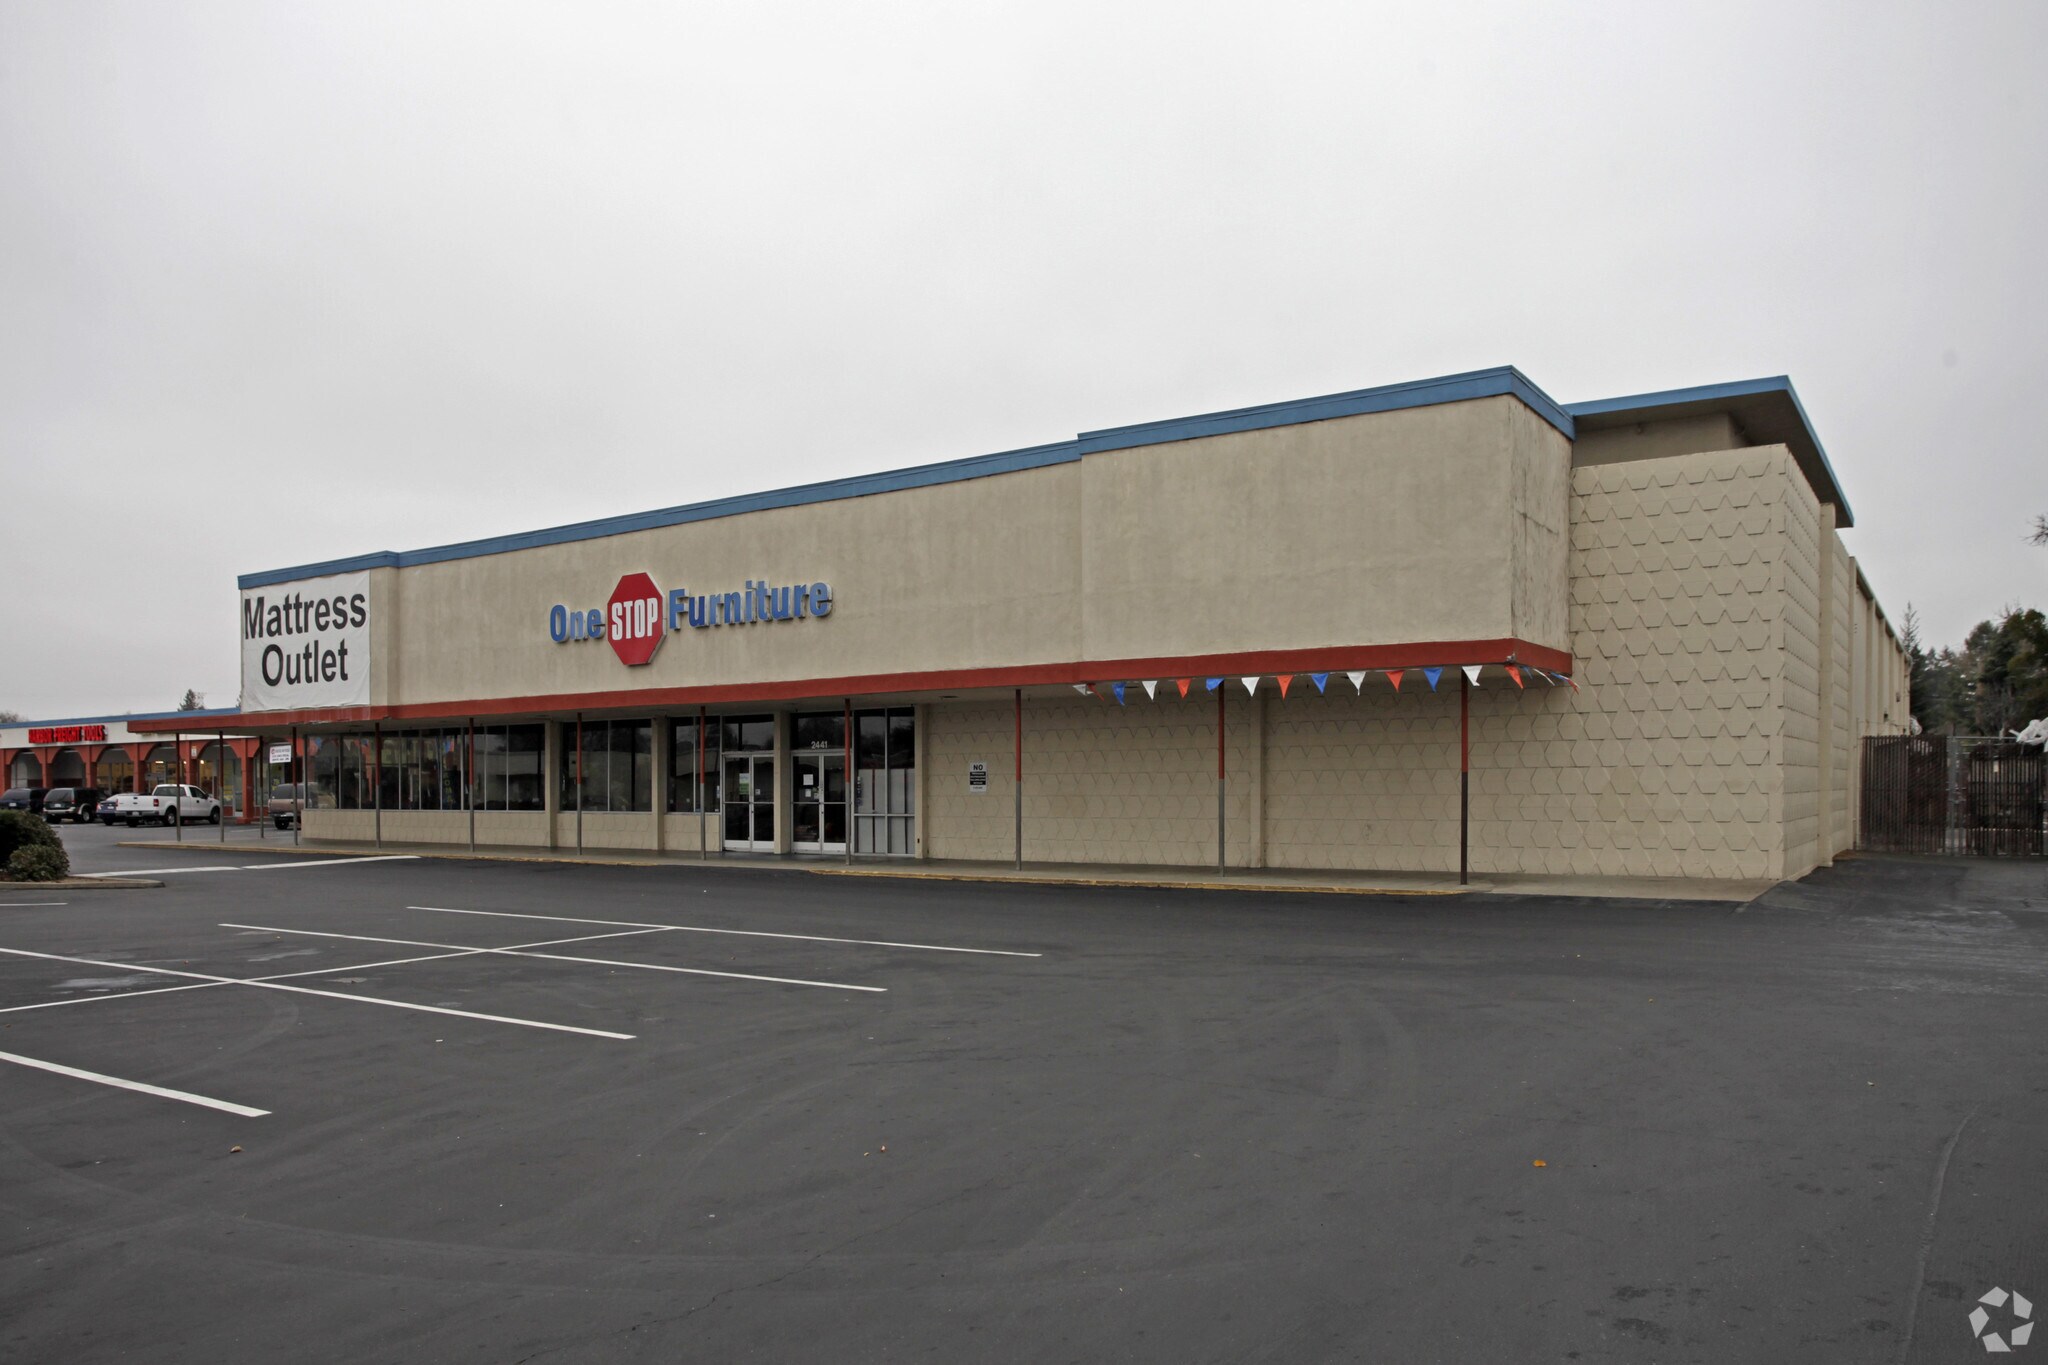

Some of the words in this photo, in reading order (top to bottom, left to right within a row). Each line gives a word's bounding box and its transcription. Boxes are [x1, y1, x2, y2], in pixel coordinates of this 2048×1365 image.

[244, 592, 367, 640] Mattress
[549, 604, 605, 643] One
[611, 597, 658, 641] STOP
[669, 580, 833, 630] Furniture
[262, 638, 349, 687] Outlet
[54, 726, 82, 742] FREIGHT
[83, 725, 106, 741] TOOLS
[811, 741, 828, 749] 2441
